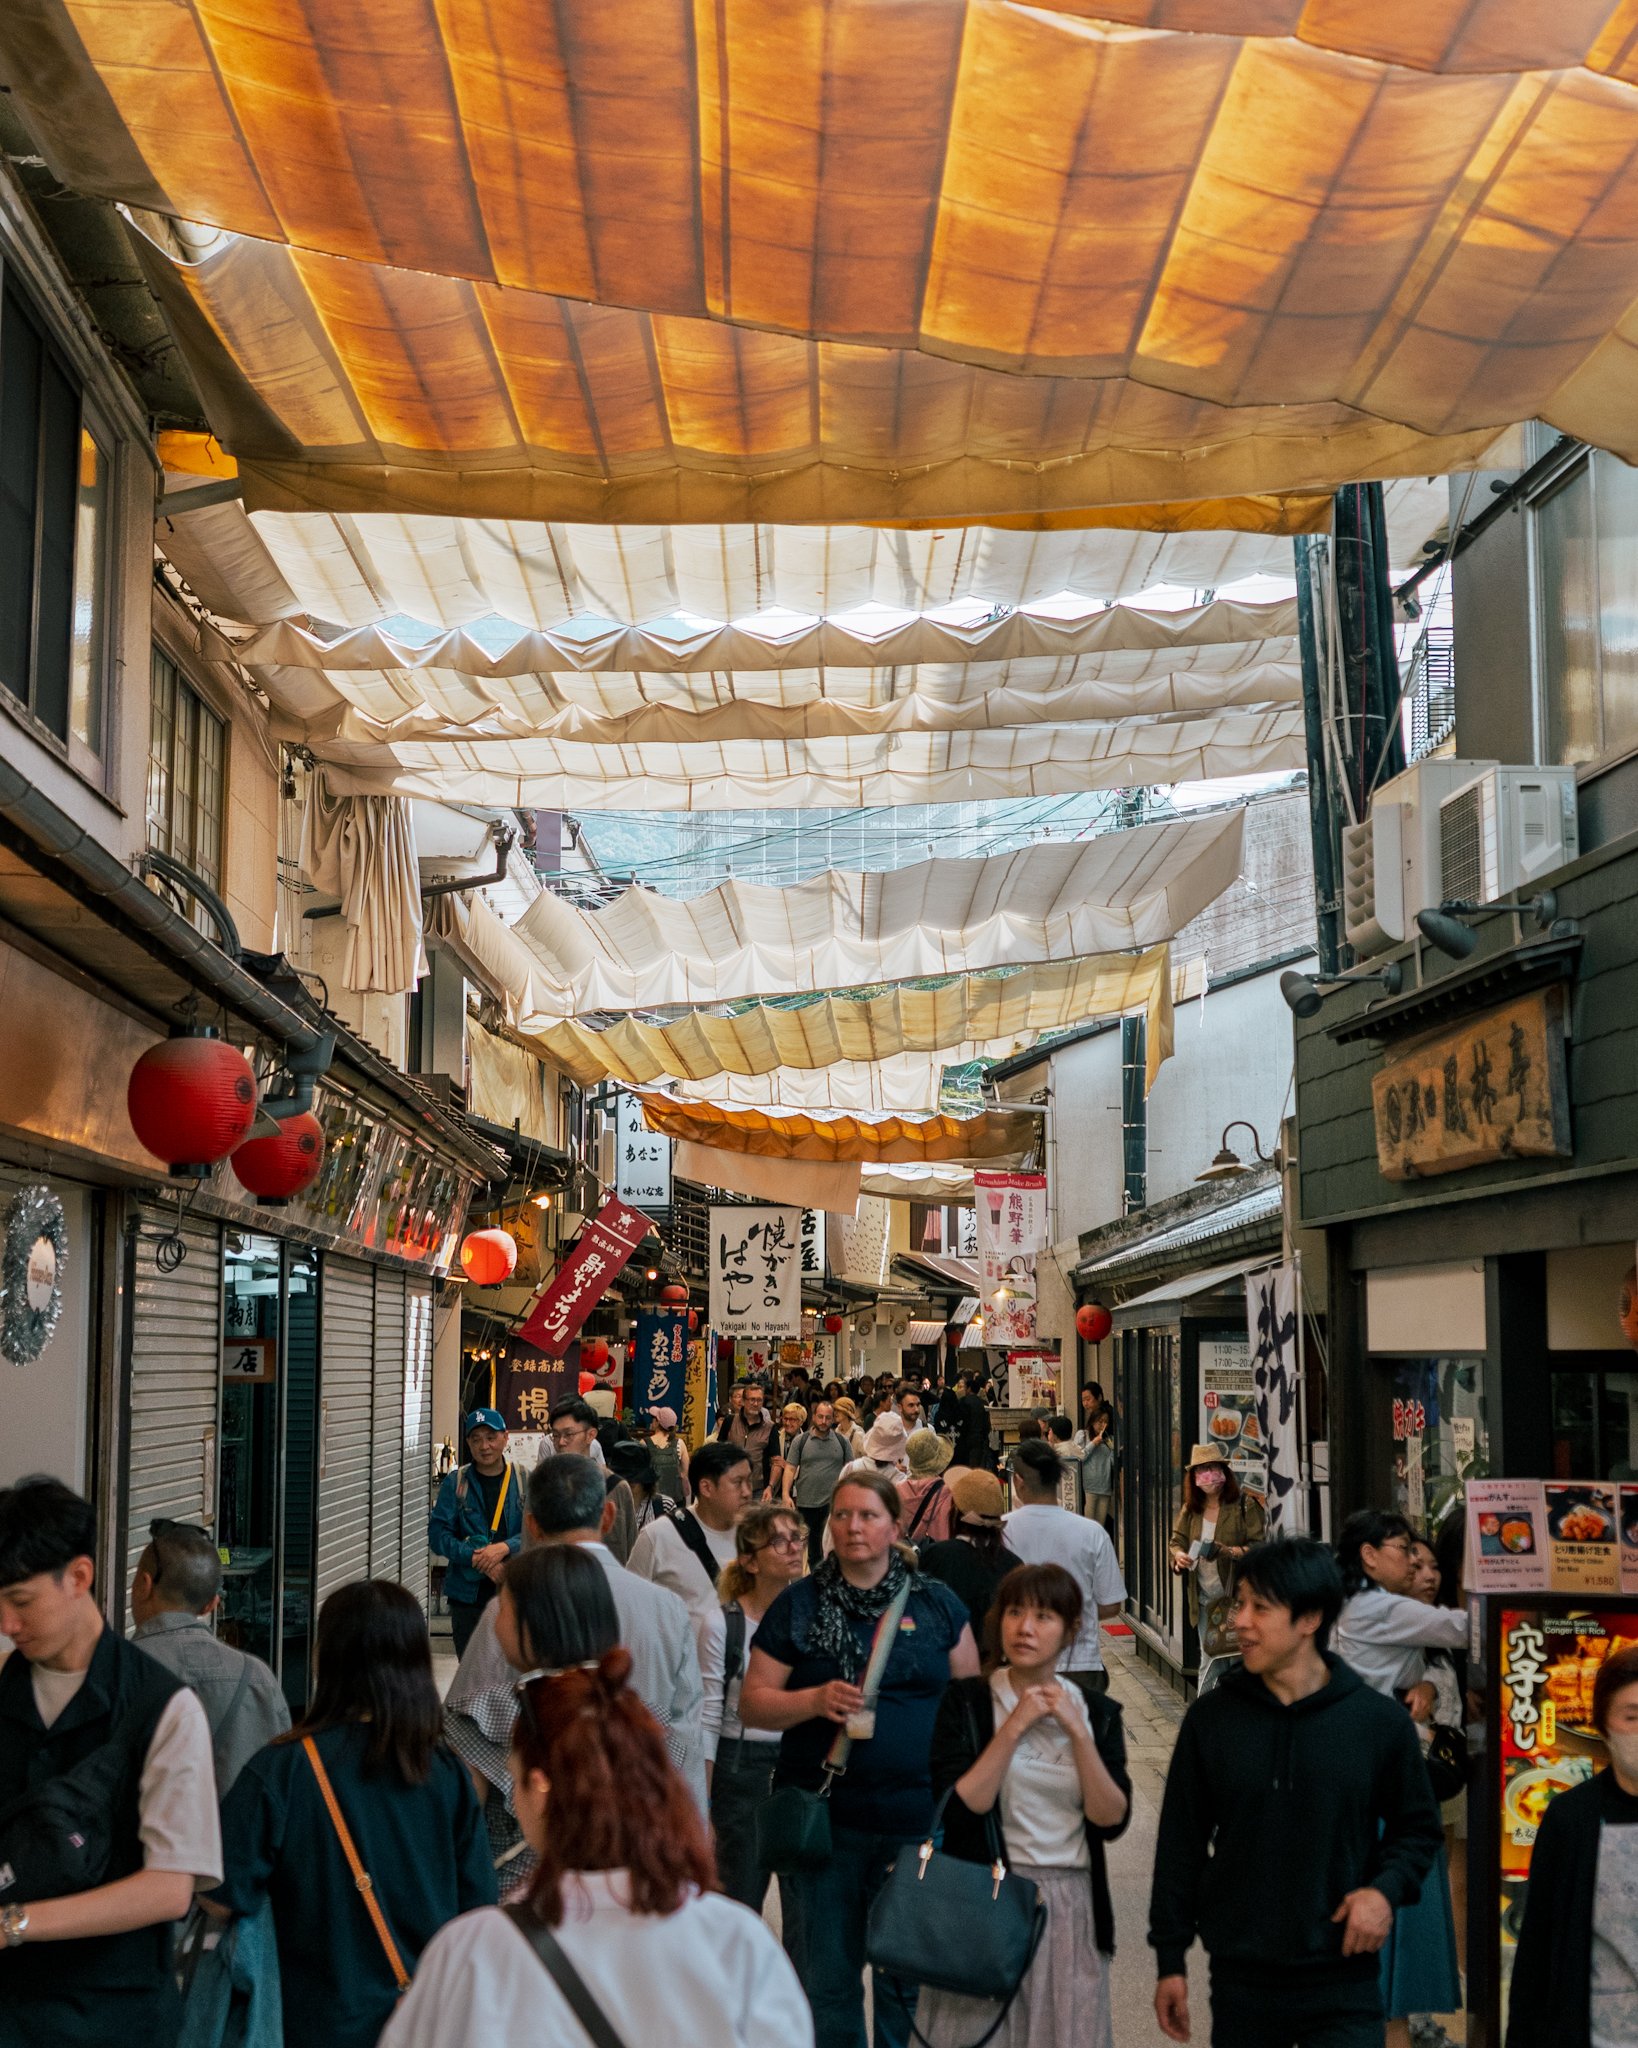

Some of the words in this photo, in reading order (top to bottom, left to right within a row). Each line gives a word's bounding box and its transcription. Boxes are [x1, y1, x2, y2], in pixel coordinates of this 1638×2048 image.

[625, 1144, 663, 1163] あなご
[1008, 1192, 1024, 1245] 熊野筆
[720, 1233, 754, 1315] はやし
[748, 1215, 794, 1307] 焼がきの
[720, 1322, 747, 1333] Yakigaki
[751, 1322, 761, 1330] No
[765, 1322, 790, 1333] Hayashi
[231, 1347, 258, 1373] 店
[647, 1328, 671, 1401] あなごめし
[476, 1411, 485, 1422] LA
[1544, 1627, 1574, 1635] Conger
[1588, 1627, 1606, 1635] Rice
[1504, 1621, 1549, 1750] 穴子めし
